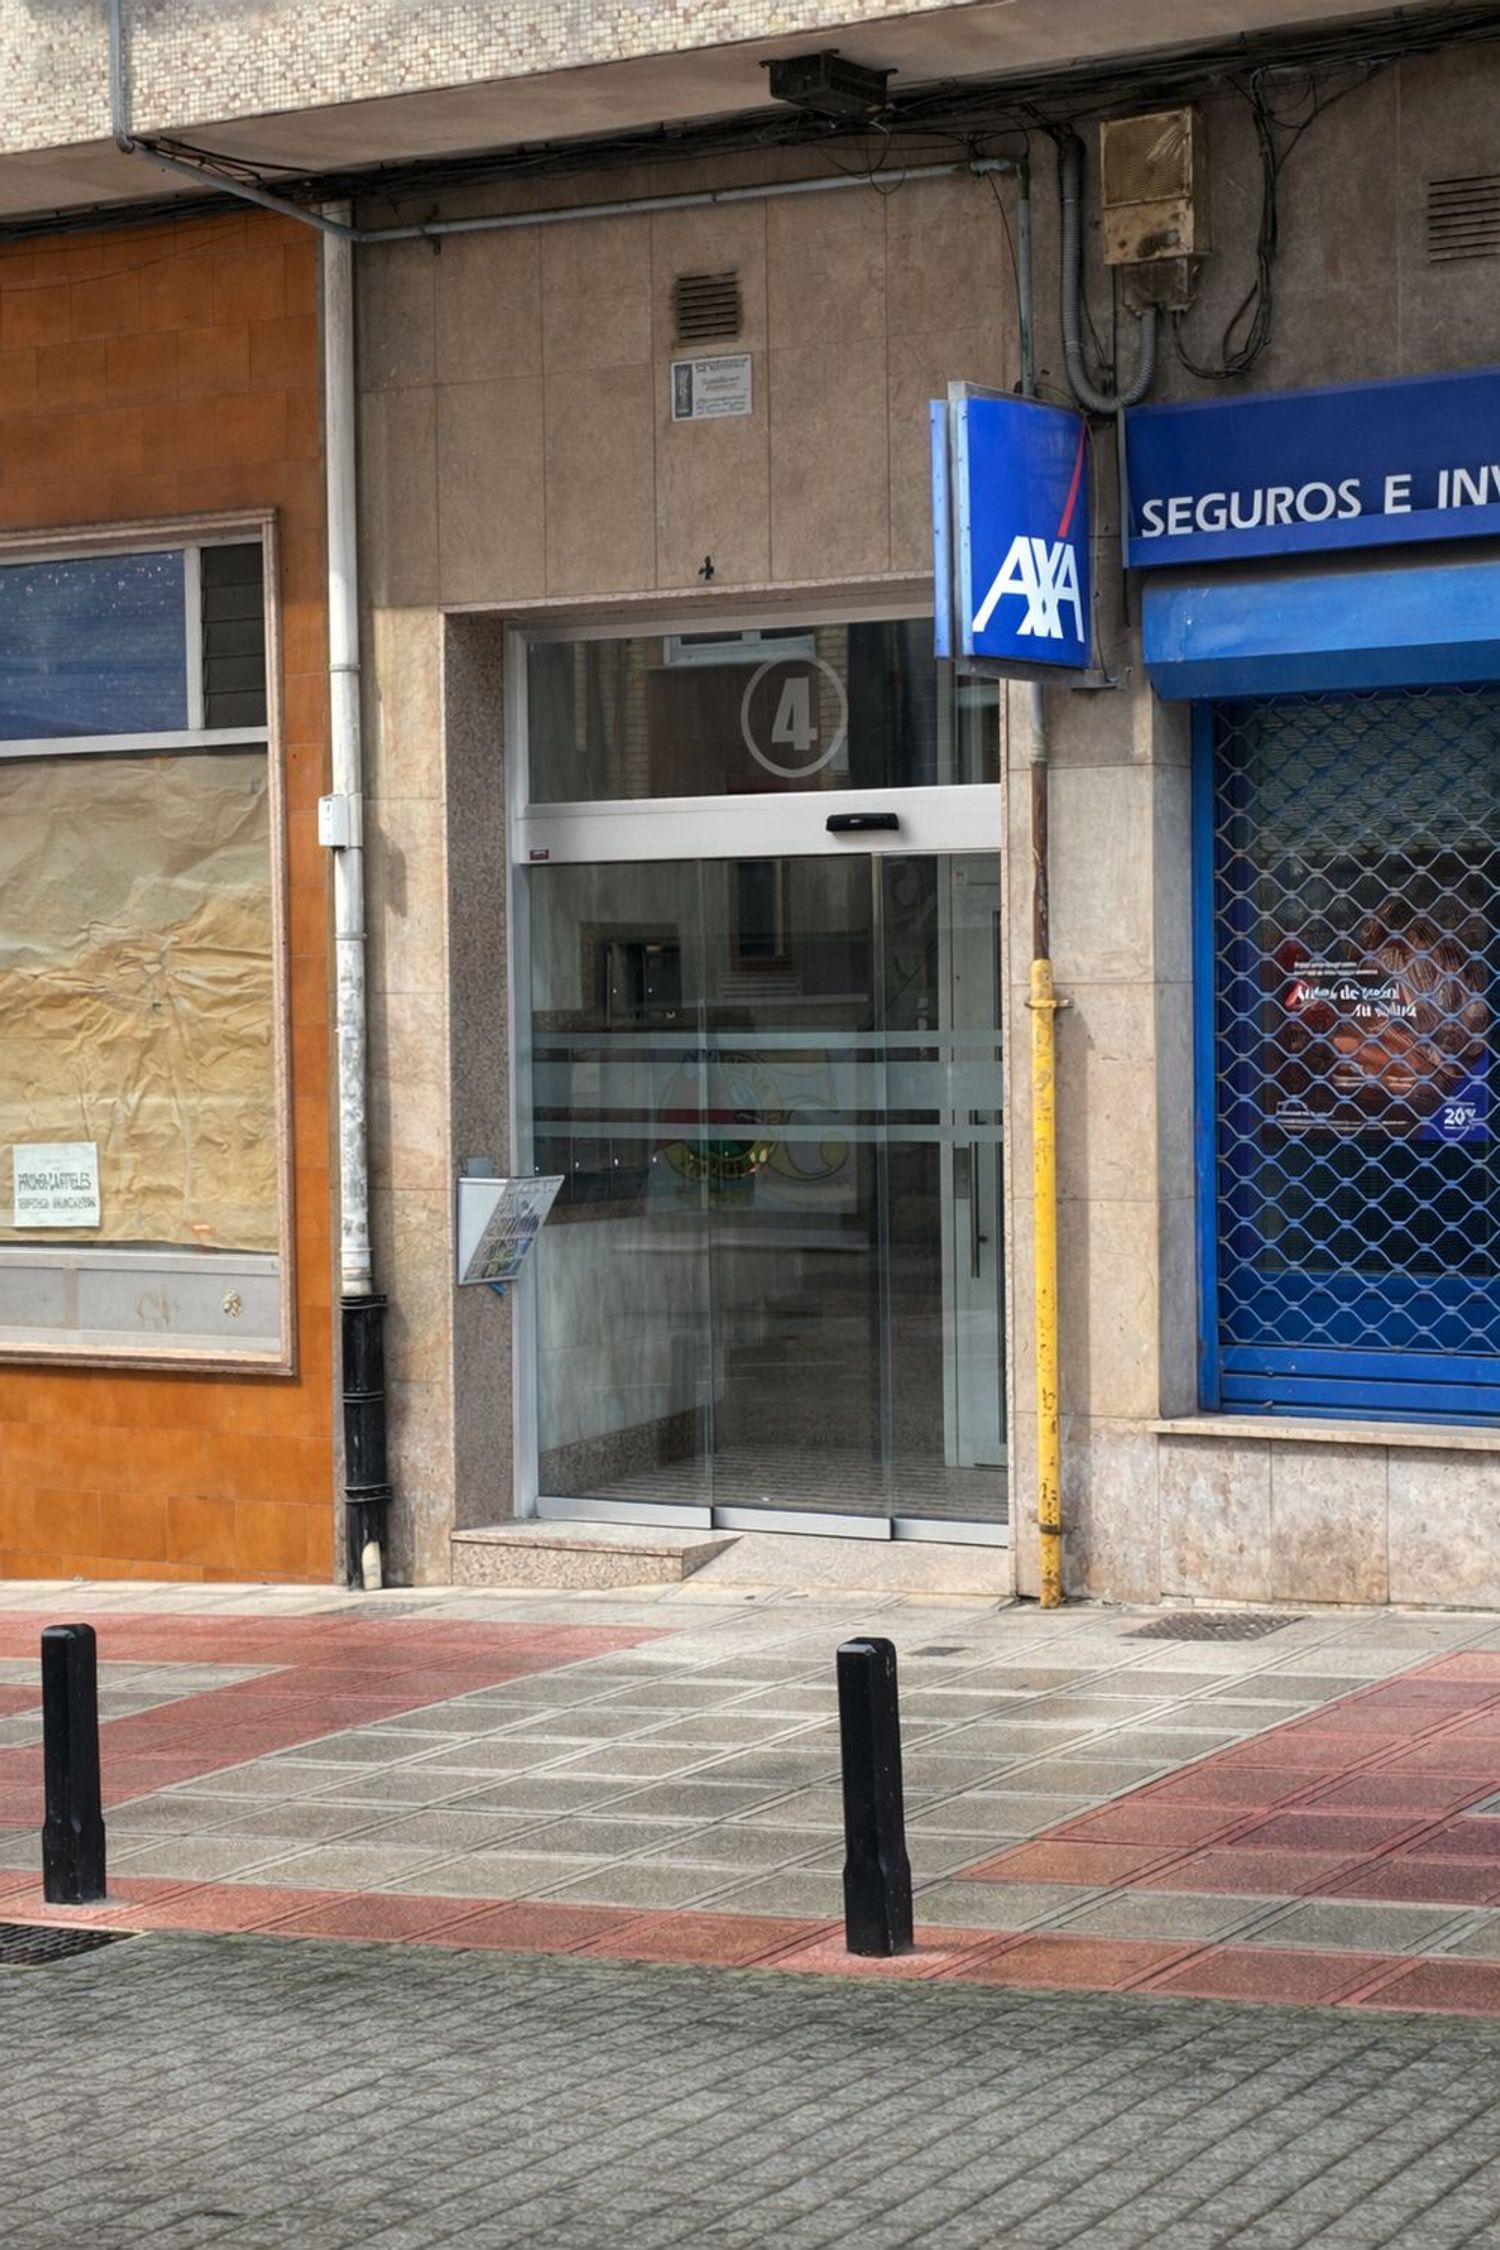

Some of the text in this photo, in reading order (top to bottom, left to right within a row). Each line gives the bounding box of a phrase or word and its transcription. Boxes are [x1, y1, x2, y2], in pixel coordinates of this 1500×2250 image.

[1141, 478, 1362, 538] SEGUROS
[1384, 473, 1412, 515] E
[971, 535, 1085, 644] AXA
[771, 676, 818, 751] 4
